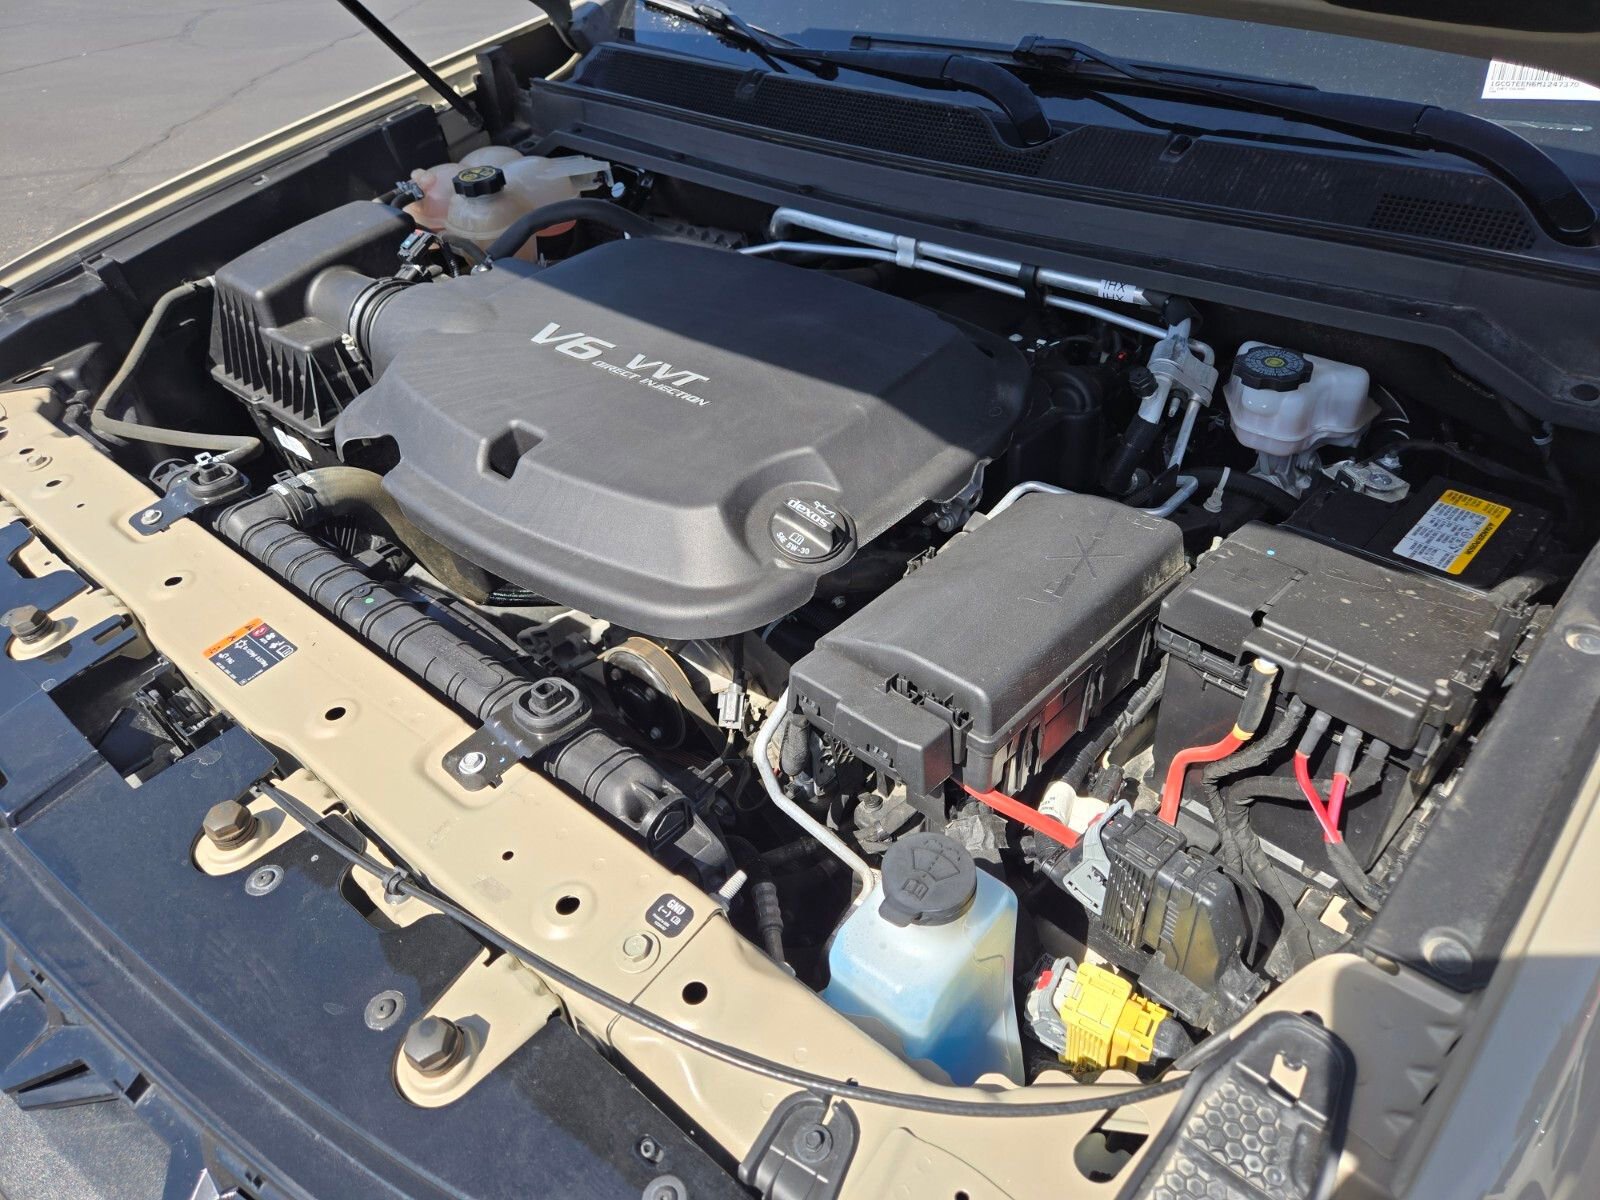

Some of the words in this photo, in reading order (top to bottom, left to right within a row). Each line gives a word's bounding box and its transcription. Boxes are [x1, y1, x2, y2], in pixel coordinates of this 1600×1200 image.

[530, 322, 617, 360] V6
[626, 353, 710, 386] VVT
[591, 360, 642, 379] DIRECT
[639, 378, 712, 406] INJECTION
[787, 498, 831, 528] dexos
[785, 541, 810, 555] 5W-30
[666, 899, 686, 915] GND
